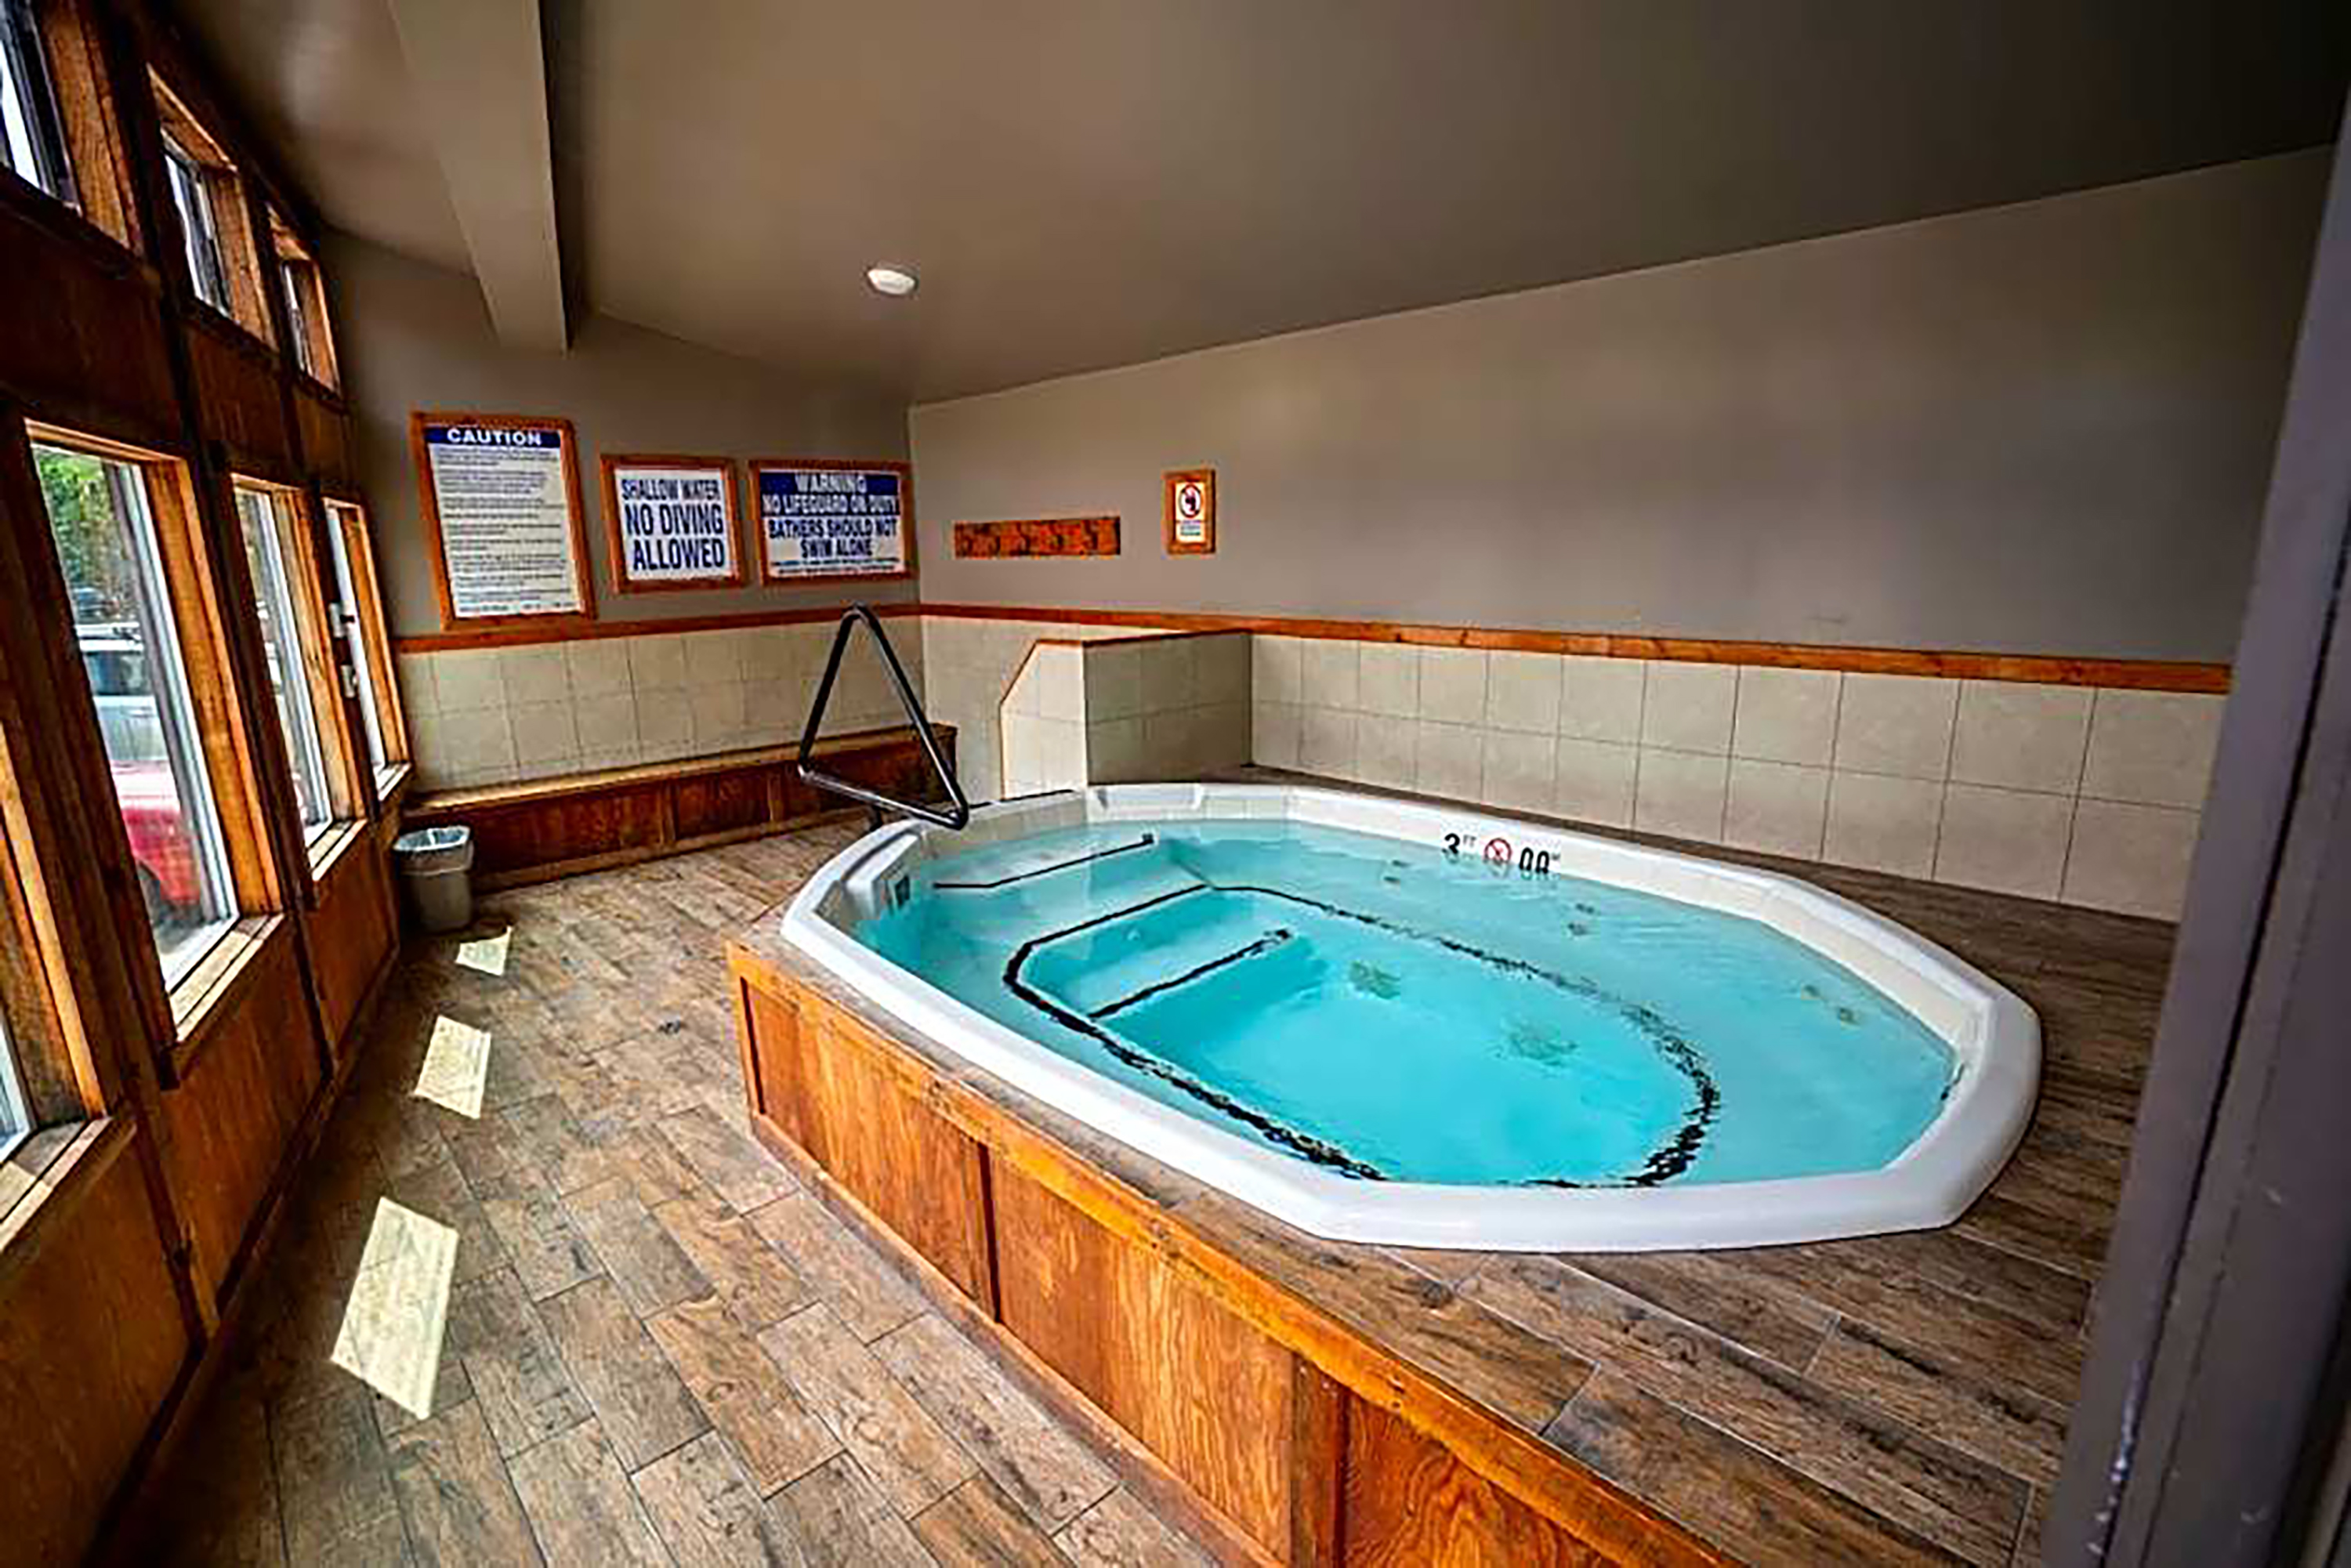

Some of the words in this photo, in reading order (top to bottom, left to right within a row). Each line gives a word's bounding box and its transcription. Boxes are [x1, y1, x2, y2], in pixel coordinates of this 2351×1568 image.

[447, 429, 542, 446] CAUTION
[621, 479, 679, 499] SHALLOW
[681, 480, 721, 499] WATER
[795, 473, 867, 493] WARNING
[763, 495, 781, 514] NO
[783, 494, 847, 514] LIFEGUARD
[850, 494, 867, 514] ON
[869, 494, 897, 514] DUTY
[625, 504, 654, 535] NO
[659, 504, 724, 535] DIVING
[769, 519, 824, 538] BATHERS
[828, 519, 872, 538] SHOULD
[876, 519, 897, 537] NOT
[632, 539, 726, 570] ALLOWED
[801, 538, 832, 558] SWIM
[836, 538, 872, 556] ALONE
